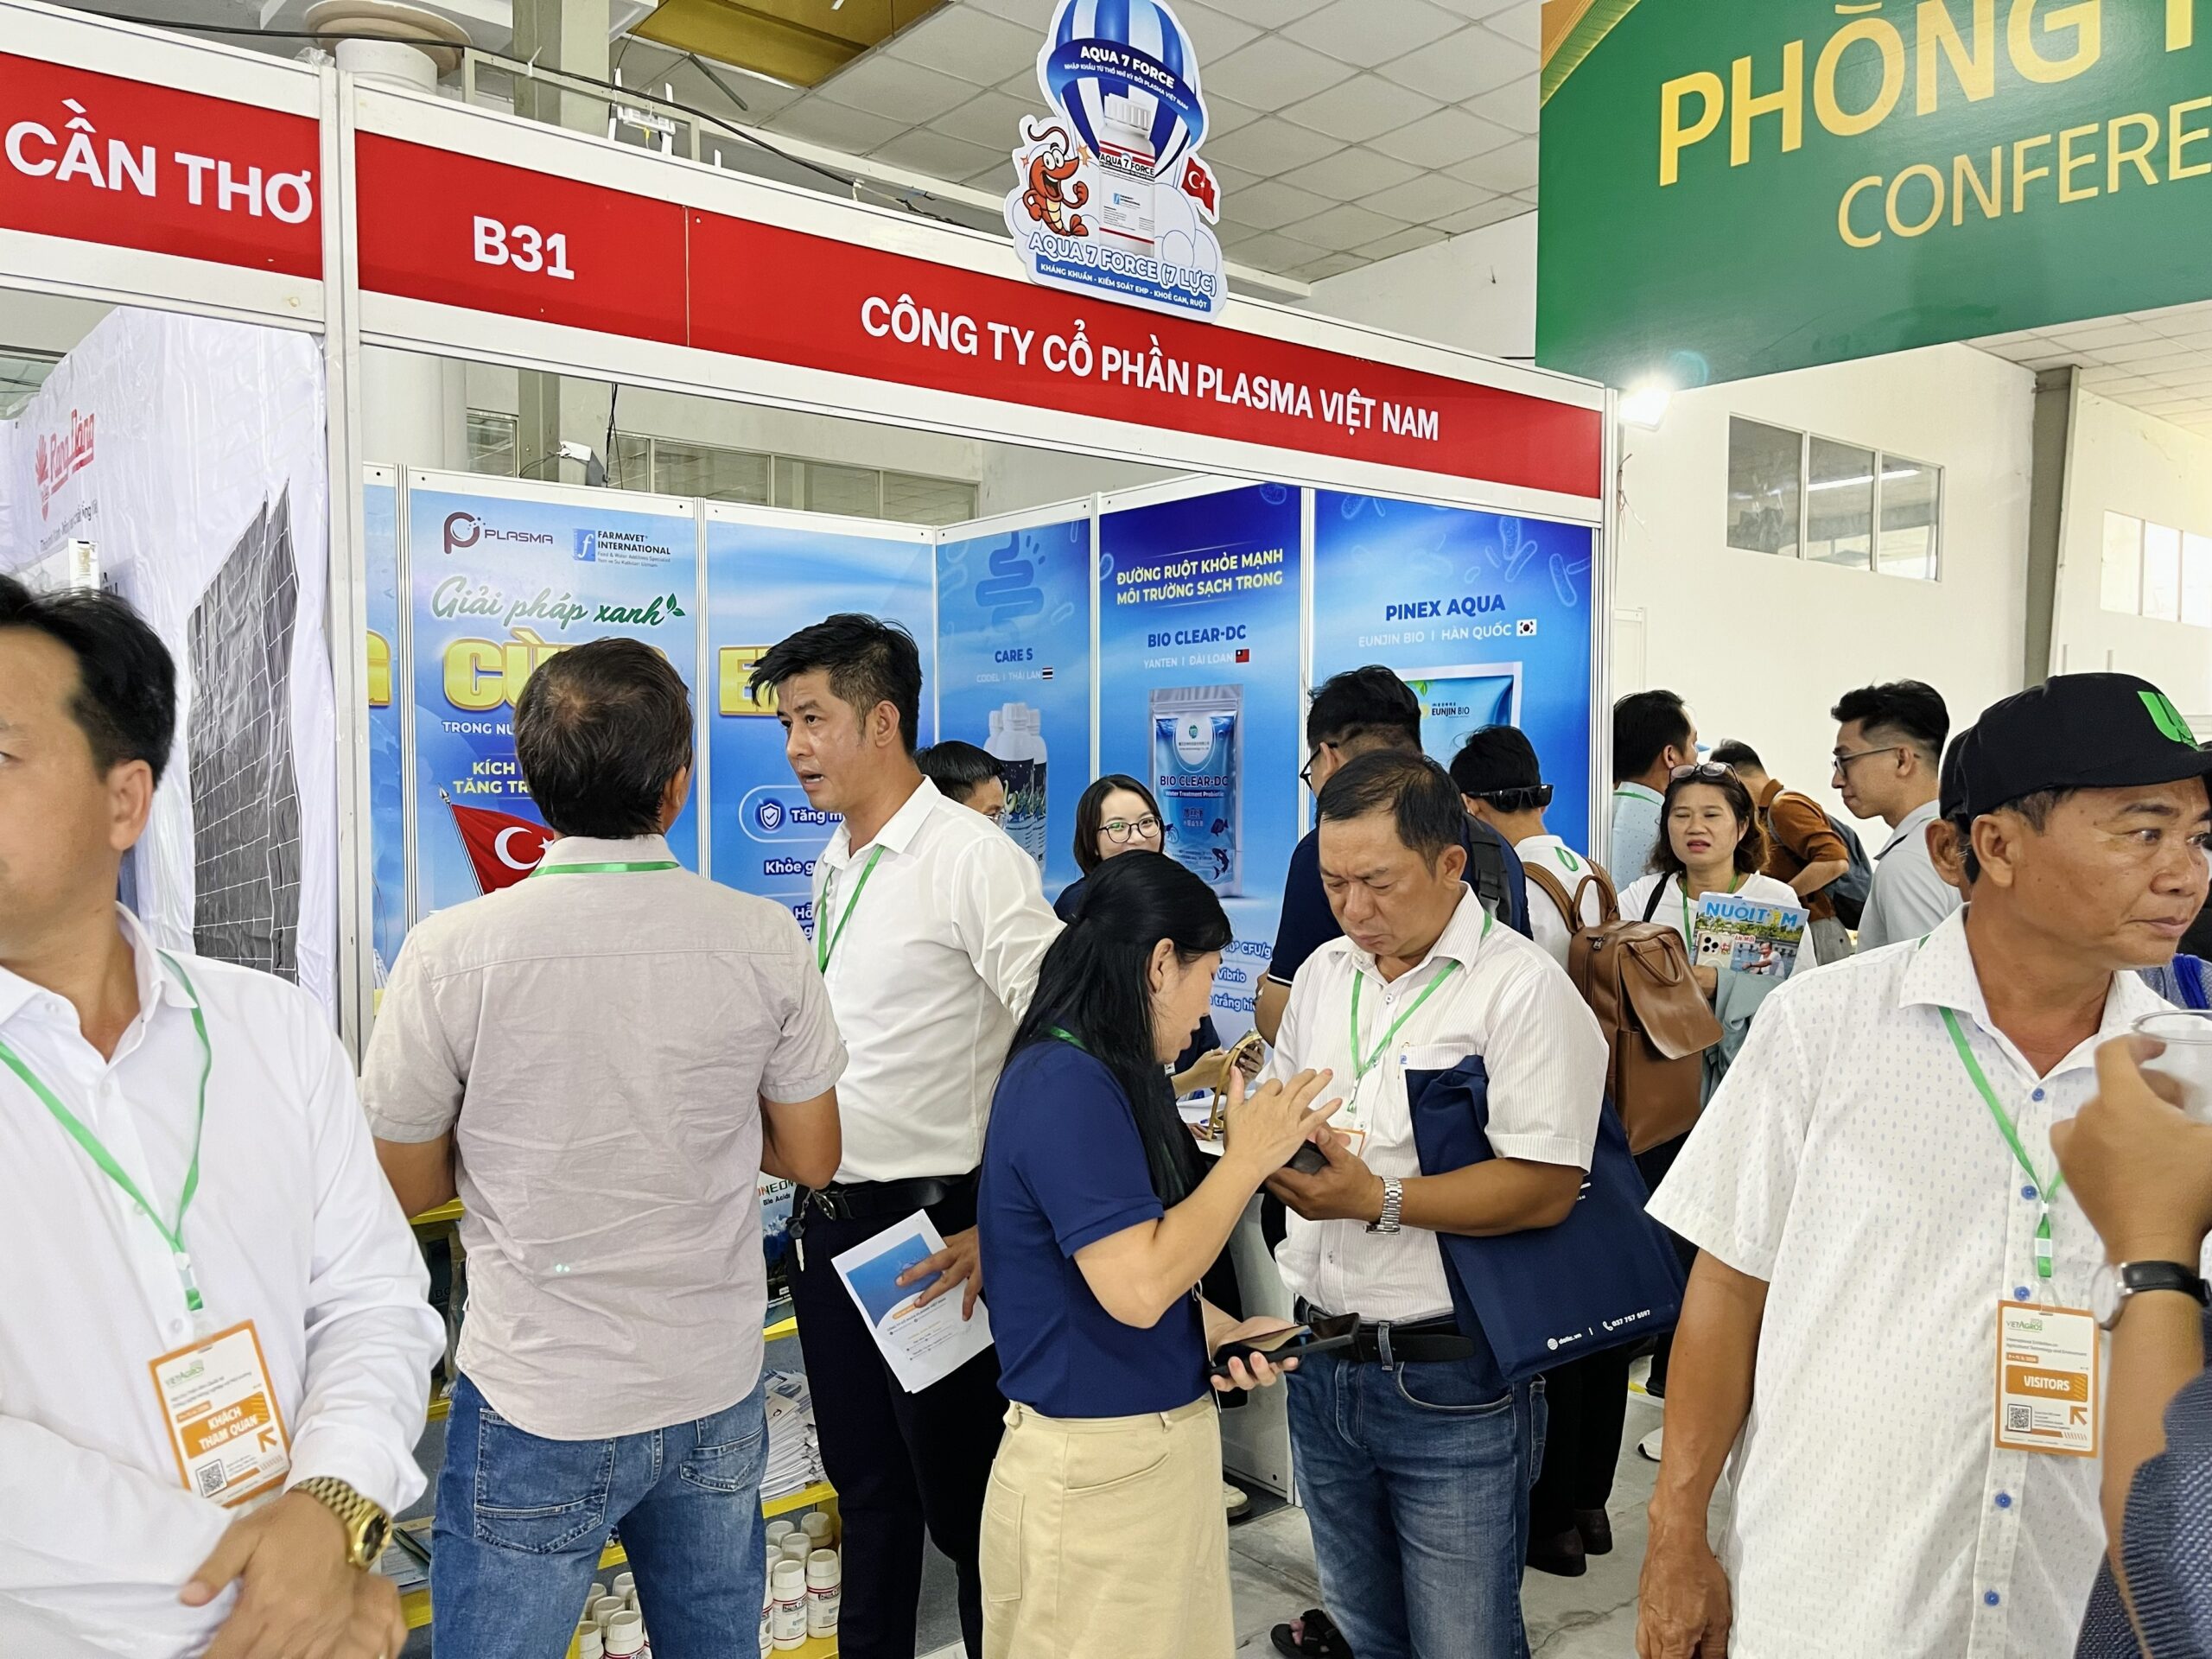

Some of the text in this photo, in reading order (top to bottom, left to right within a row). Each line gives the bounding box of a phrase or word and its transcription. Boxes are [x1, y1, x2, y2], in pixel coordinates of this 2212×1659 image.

[1081, 46, 1175, 89] AQUA 7 FORCE
[4, 98, 314, 225] CẦN THƠ
[1100, 154, 1155, 175] AQUA 7 FORCE
[1838, 96, 2212, 248] CONFERE
[473, 214, 575, 281] B31
[1029, 232, 1217, 296] AQUA 7 FORCE (7 LỰC)
[1040, 263, 1066, 276] KHÁNG
[1067, 268, 1093, 282] KHUẨN
[1116, 279, 1135, 292] SOÁT
[1135, 286, 1149, 296] EHP
[1190, 297, 1207, 309] RUỘT
[861, 294, 1439, 442] CÔNG TY CỔ PHẦN PLASMA VIỆT NAM
[484, 529, 554, 545] PLASMA
[597, 530, 645, 543] FARMAVET
[597, 541, 671, 555] INTERNATIONAL
[1116, 548, 1283, 586] ĐƯỜNG RUỘT KHỎE MẠNH
[1116, 570, 1283, 605] MÔI TRƯỜNG SẠCH TRONG
[432, 575, 665, 630] Giải pháp xanh
[1385, 594, 1506, 621] PINEX AQUA
[1147, 624, 1247, 648] BIO CLEAR-DC
[1357, 632, 1401, 648] EUNJIN
[1403, 631, 1425, 644] BIO
[1441, 625, 1470, 640] HÀN
[1472, 620, 1512, 639] QUỐC
[995, 647, 1033, 664] CARE S
[1143, 658, 1178, 670] YANTEN
[1189, 653, 1205, 666] ĐÀI
[1207, 652, 1234, 664] LOAN
[1432, 707, 1470, 716] EUNJIN BIO
[442, 721, 493, 734] TRONG
[473, 759, 516, 775] KÍCH
[453, 778, 503, 794] TĂNG
[1160, 775, 1229, 786] BIO CLEAR-DC
[791, 808, 826, 823] Tăng
[765, 861, 801, 874] Khỏe
[1242, 943, 1272, 959] CFU/g
[1217, 969, 1246, 982] Vibrio
[1214, 993, 1241, 1012] trắng
[775, 1193, 791, 1202] Acids
[2023, 1375, 2070, 1391] VISITORS
[207, 1406, 243, 1430] KHÁCH
[198, 1414, 259, 1451] THAM QUAN
